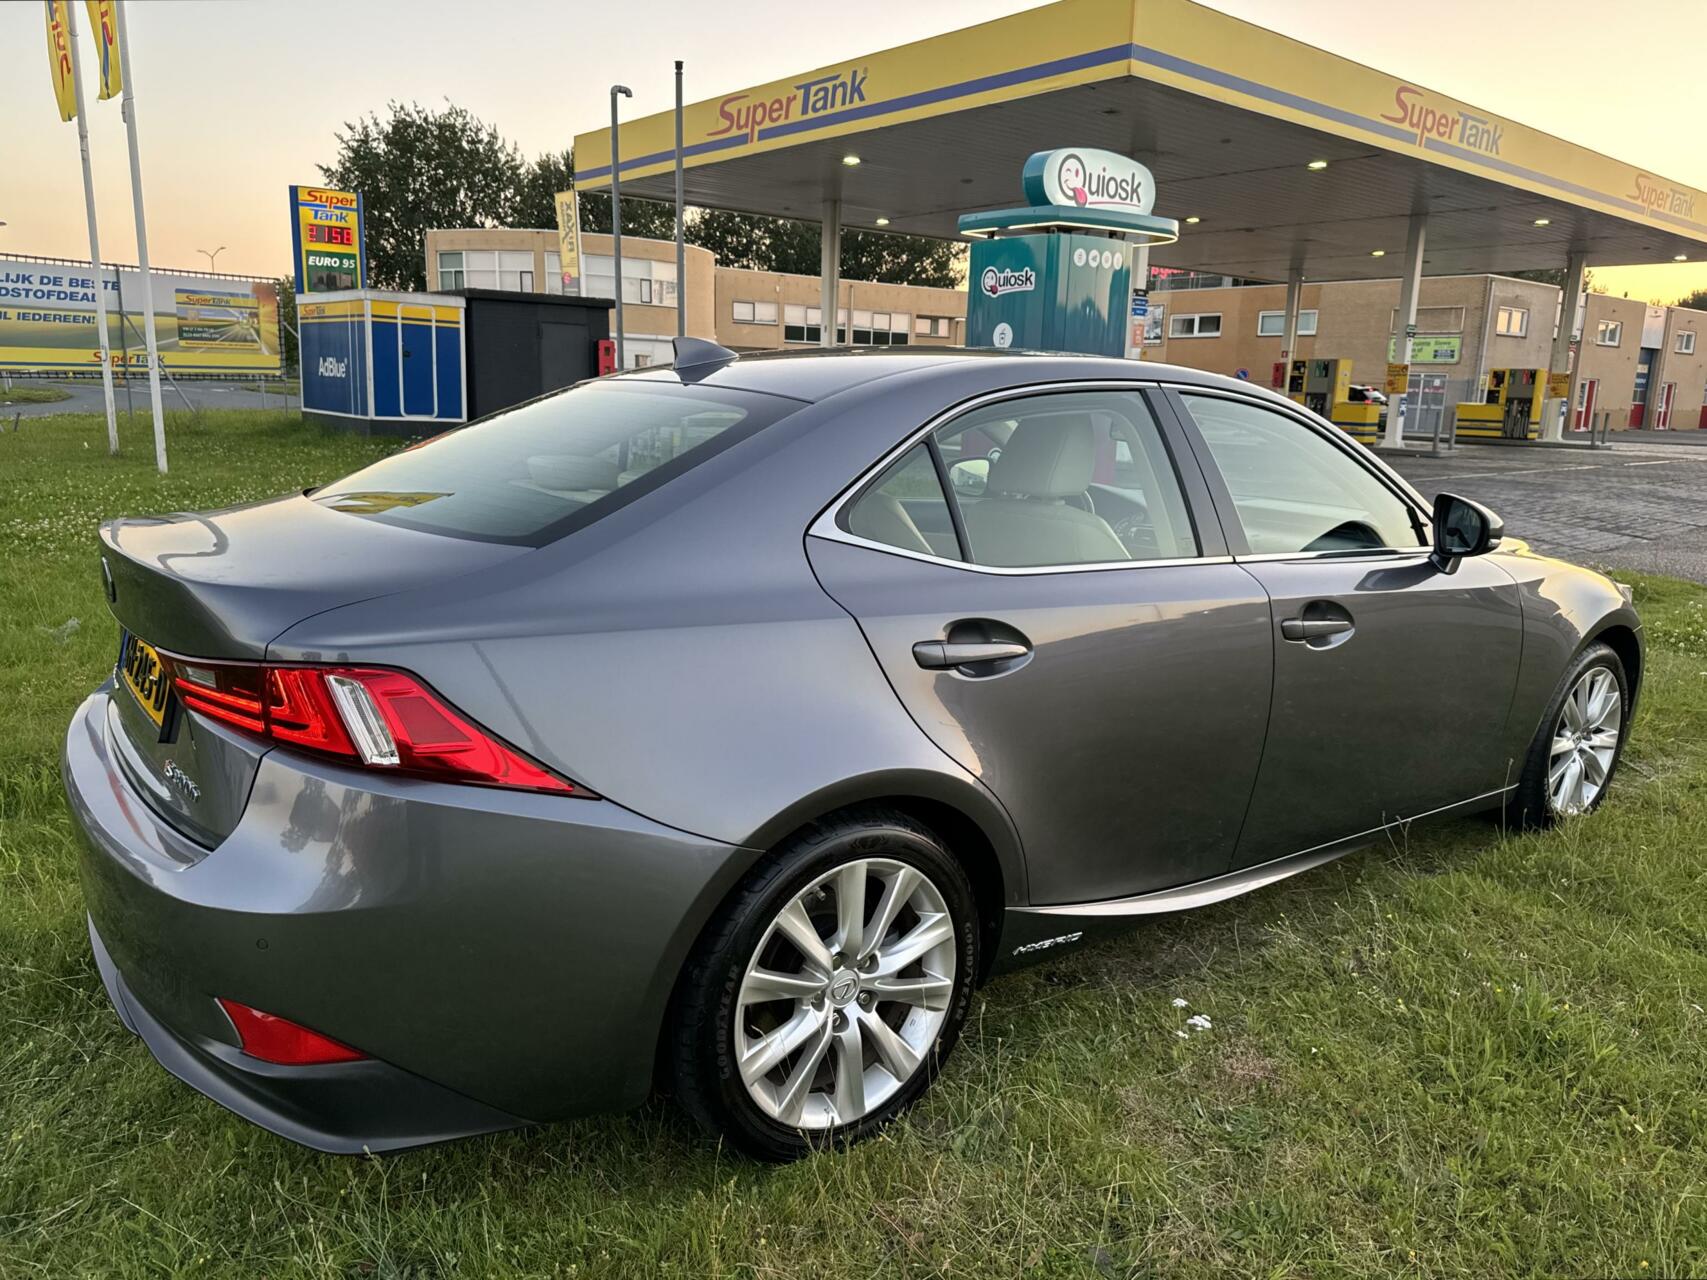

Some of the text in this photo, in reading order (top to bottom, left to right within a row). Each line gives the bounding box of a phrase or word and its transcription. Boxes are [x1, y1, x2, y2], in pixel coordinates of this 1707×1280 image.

[706, 69, 868, 143] SuperTank
[1380, 86, 1504, 155] SuperTank
[1058, 153, 1142, 204] Quiosk
[299, 190, 356, 209] Super
[1626, 174, 1696, 218] SuperTank
[310, 208, 349, 223] Tank
[308, 256, 356, 268] EURO 95
[0, 272, 34, 285] IJK
[39, 275, 64, 287] DE
[983, 268, 1034, 293] Quiosk
[17, 312, 96, 325] IEDEREEN!
[955, 921, 974, 1021] GOODYEAR
[716, 964, 740, 1080] GOODYEAR
